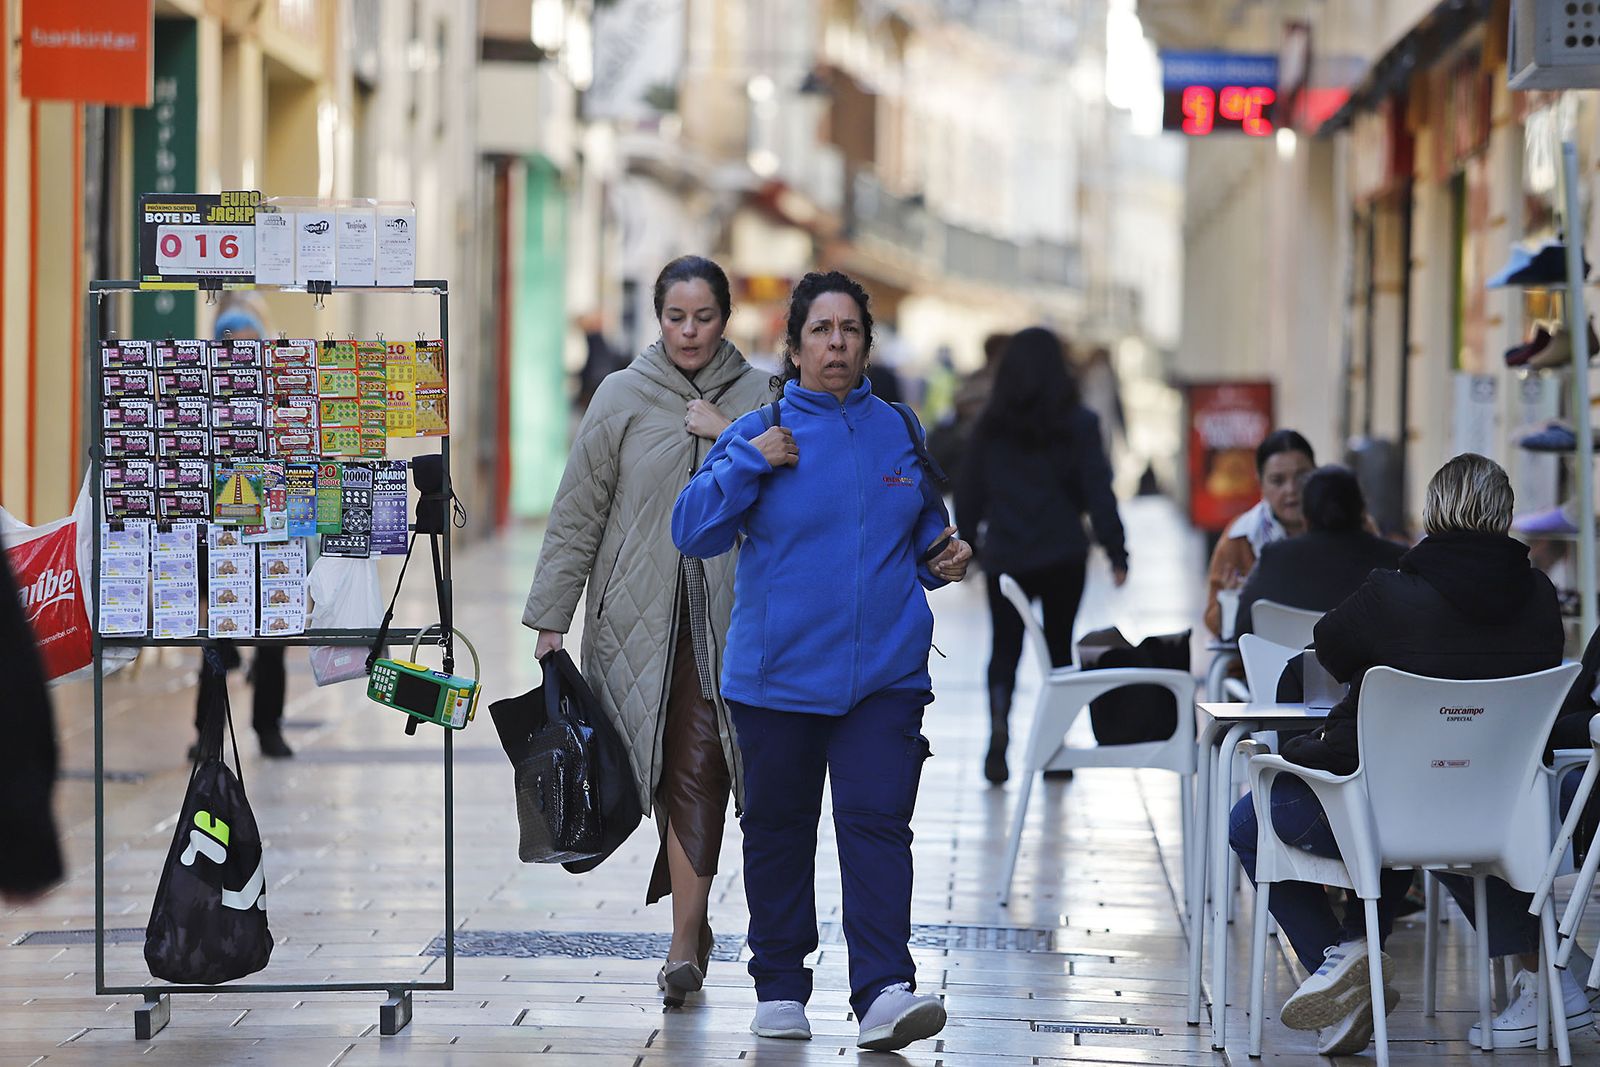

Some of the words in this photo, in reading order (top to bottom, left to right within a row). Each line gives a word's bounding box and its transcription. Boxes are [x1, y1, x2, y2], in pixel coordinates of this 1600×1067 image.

[220, 191, 261, 206] EURO
[145, 212, 180, 223] BOTE
[183, 212, 200, 223] DE
[387, 343, 405, 354] 10
[387, 390, 404, 400] 10
[374, 470, 406, 480] LONARIO
[1440, 706, 1484, 716] Cruzcampo
